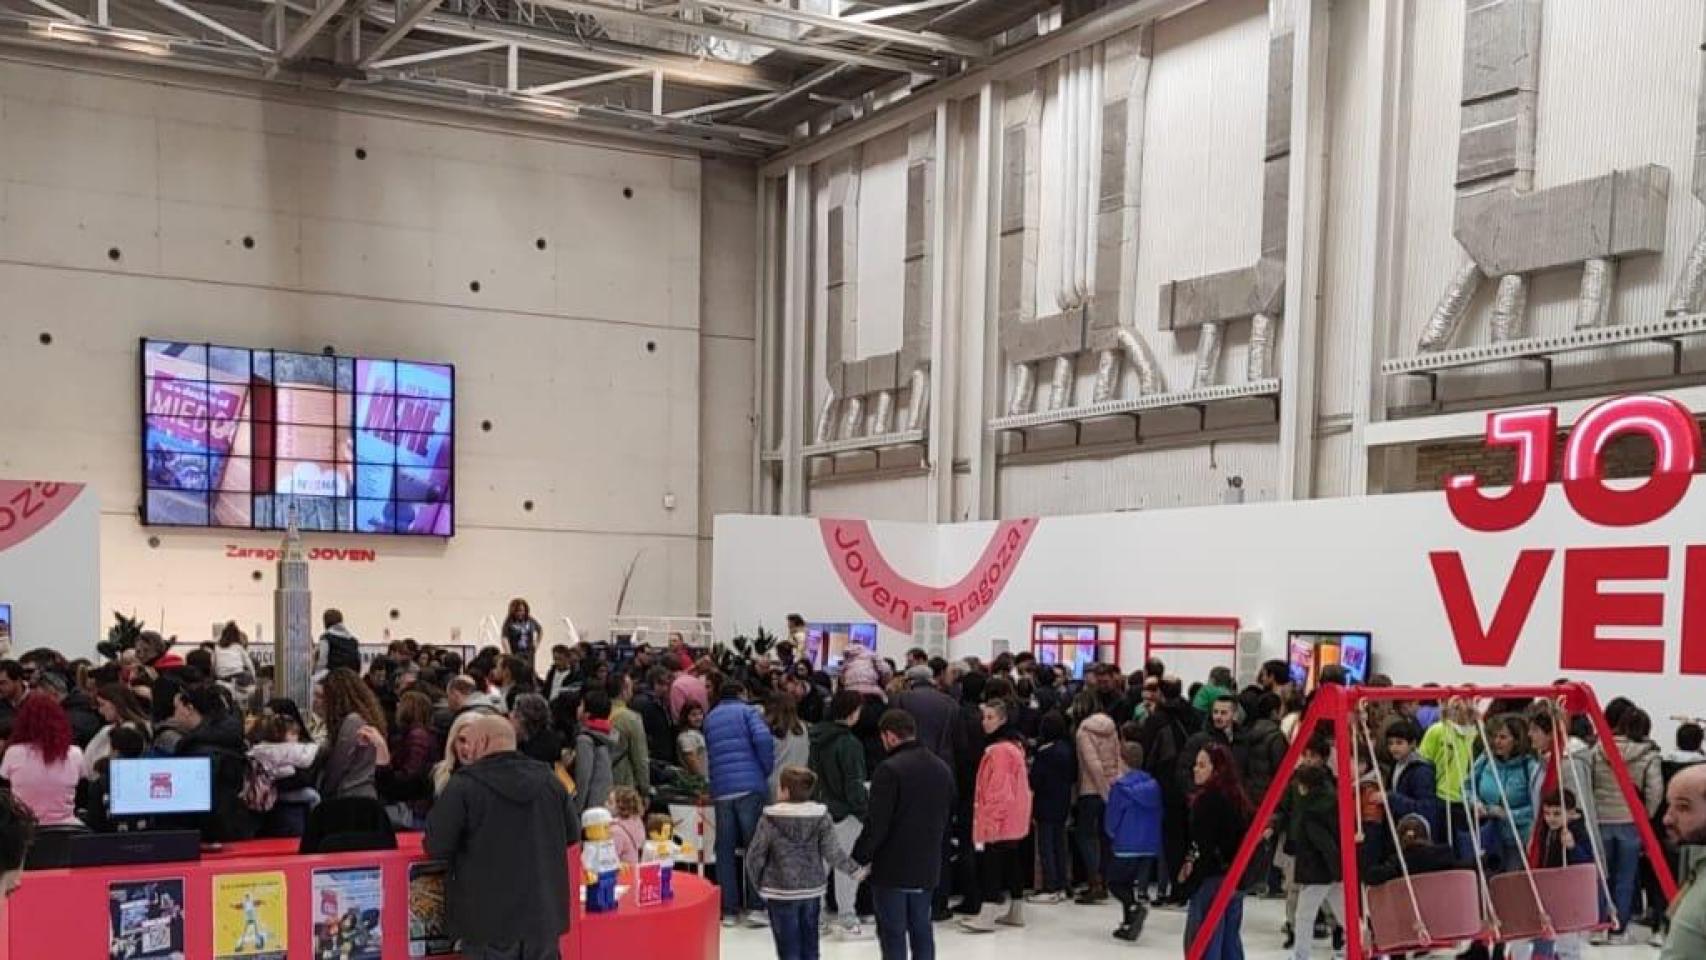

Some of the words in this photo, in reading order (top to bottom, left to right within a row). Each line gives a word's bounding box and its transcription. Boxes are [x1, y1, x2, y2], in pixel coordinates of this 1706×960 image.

[1443, 393, 1698, 533] JO
[308, 547, 376, 561] JOVEN
[835, 526, 910, 620] Joven
